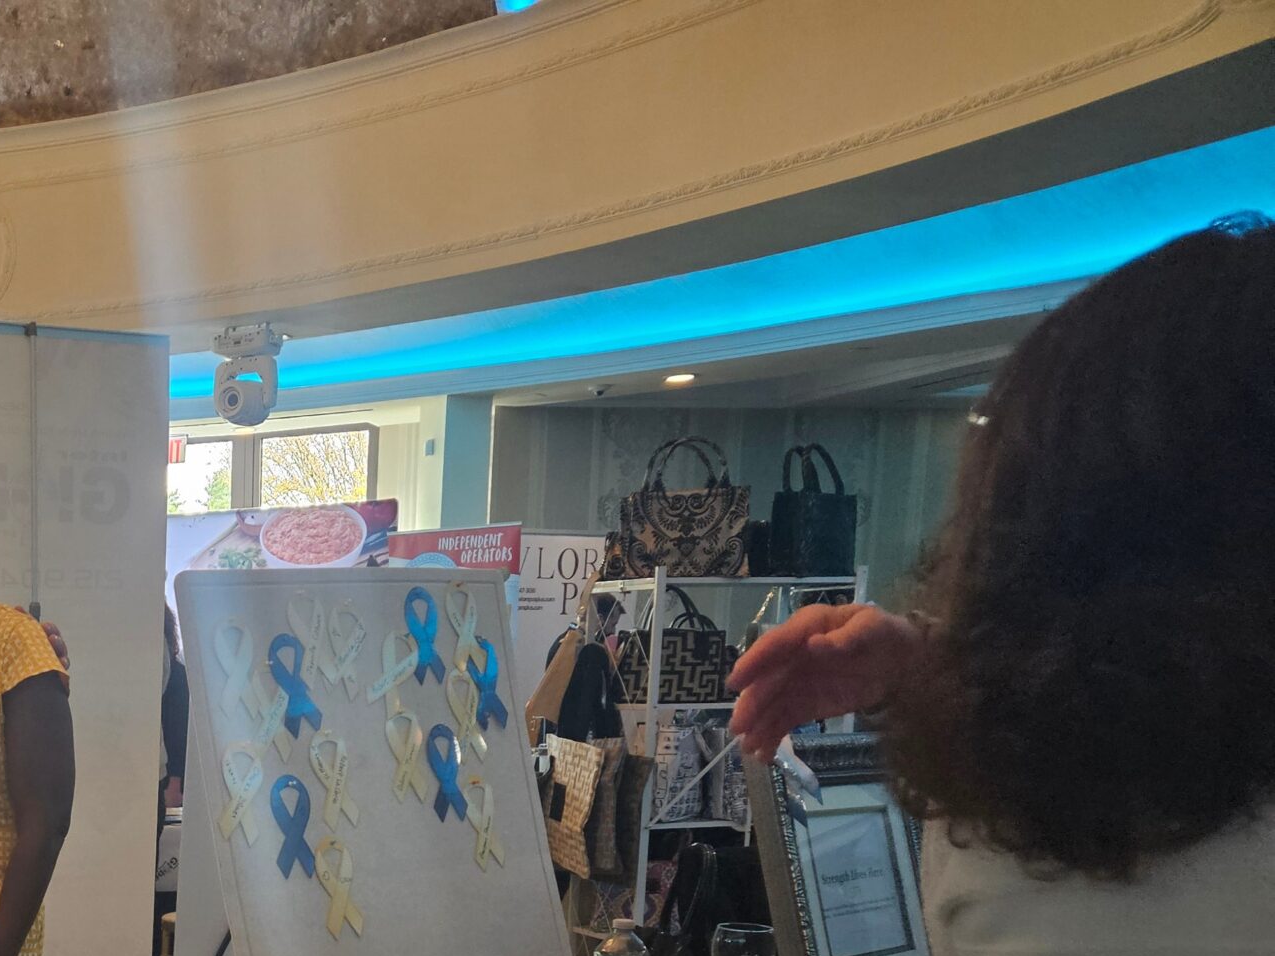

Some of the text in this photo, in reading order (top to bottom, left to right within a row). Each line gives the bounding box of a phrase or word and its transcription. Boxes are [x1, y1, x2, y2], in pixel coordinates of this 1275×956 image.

[169, 439, 182, 463] IT
[438, 532, 504, 551] INDEPENDENT
[460, 546, 513, 564] OPERATORS
